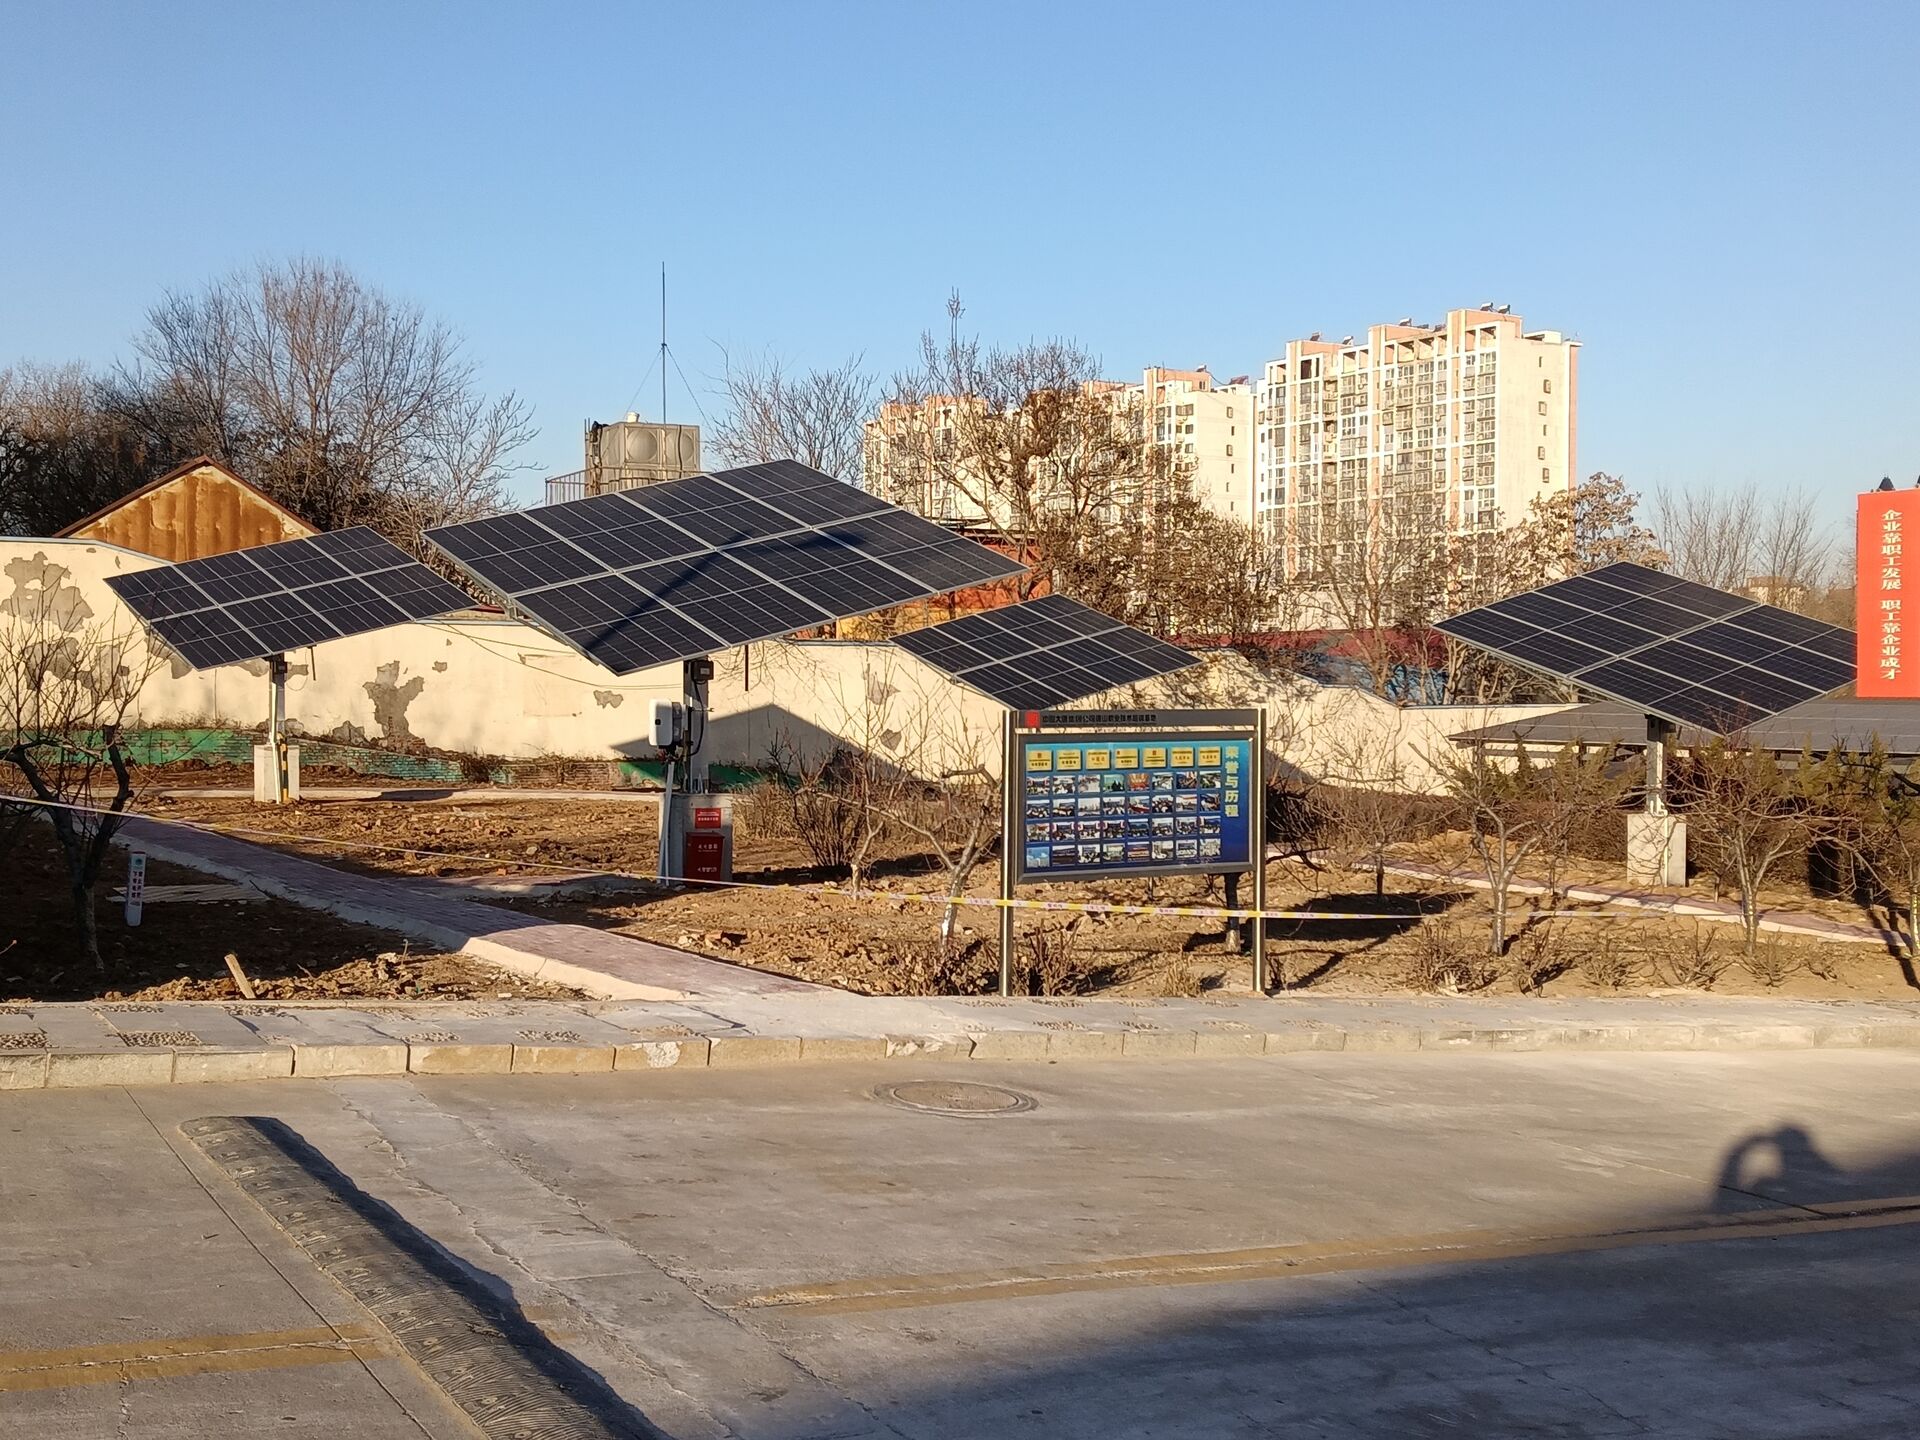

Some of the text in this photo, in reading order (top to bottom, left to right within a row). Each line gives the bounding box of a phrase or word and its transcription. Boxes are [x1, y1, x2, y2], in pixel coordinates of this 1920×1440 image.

[1880, 509, 1903, 680] 企业靠职工发展 职工靠企业成才
[1225, 745, 1240, 818] 荣誉与历程
